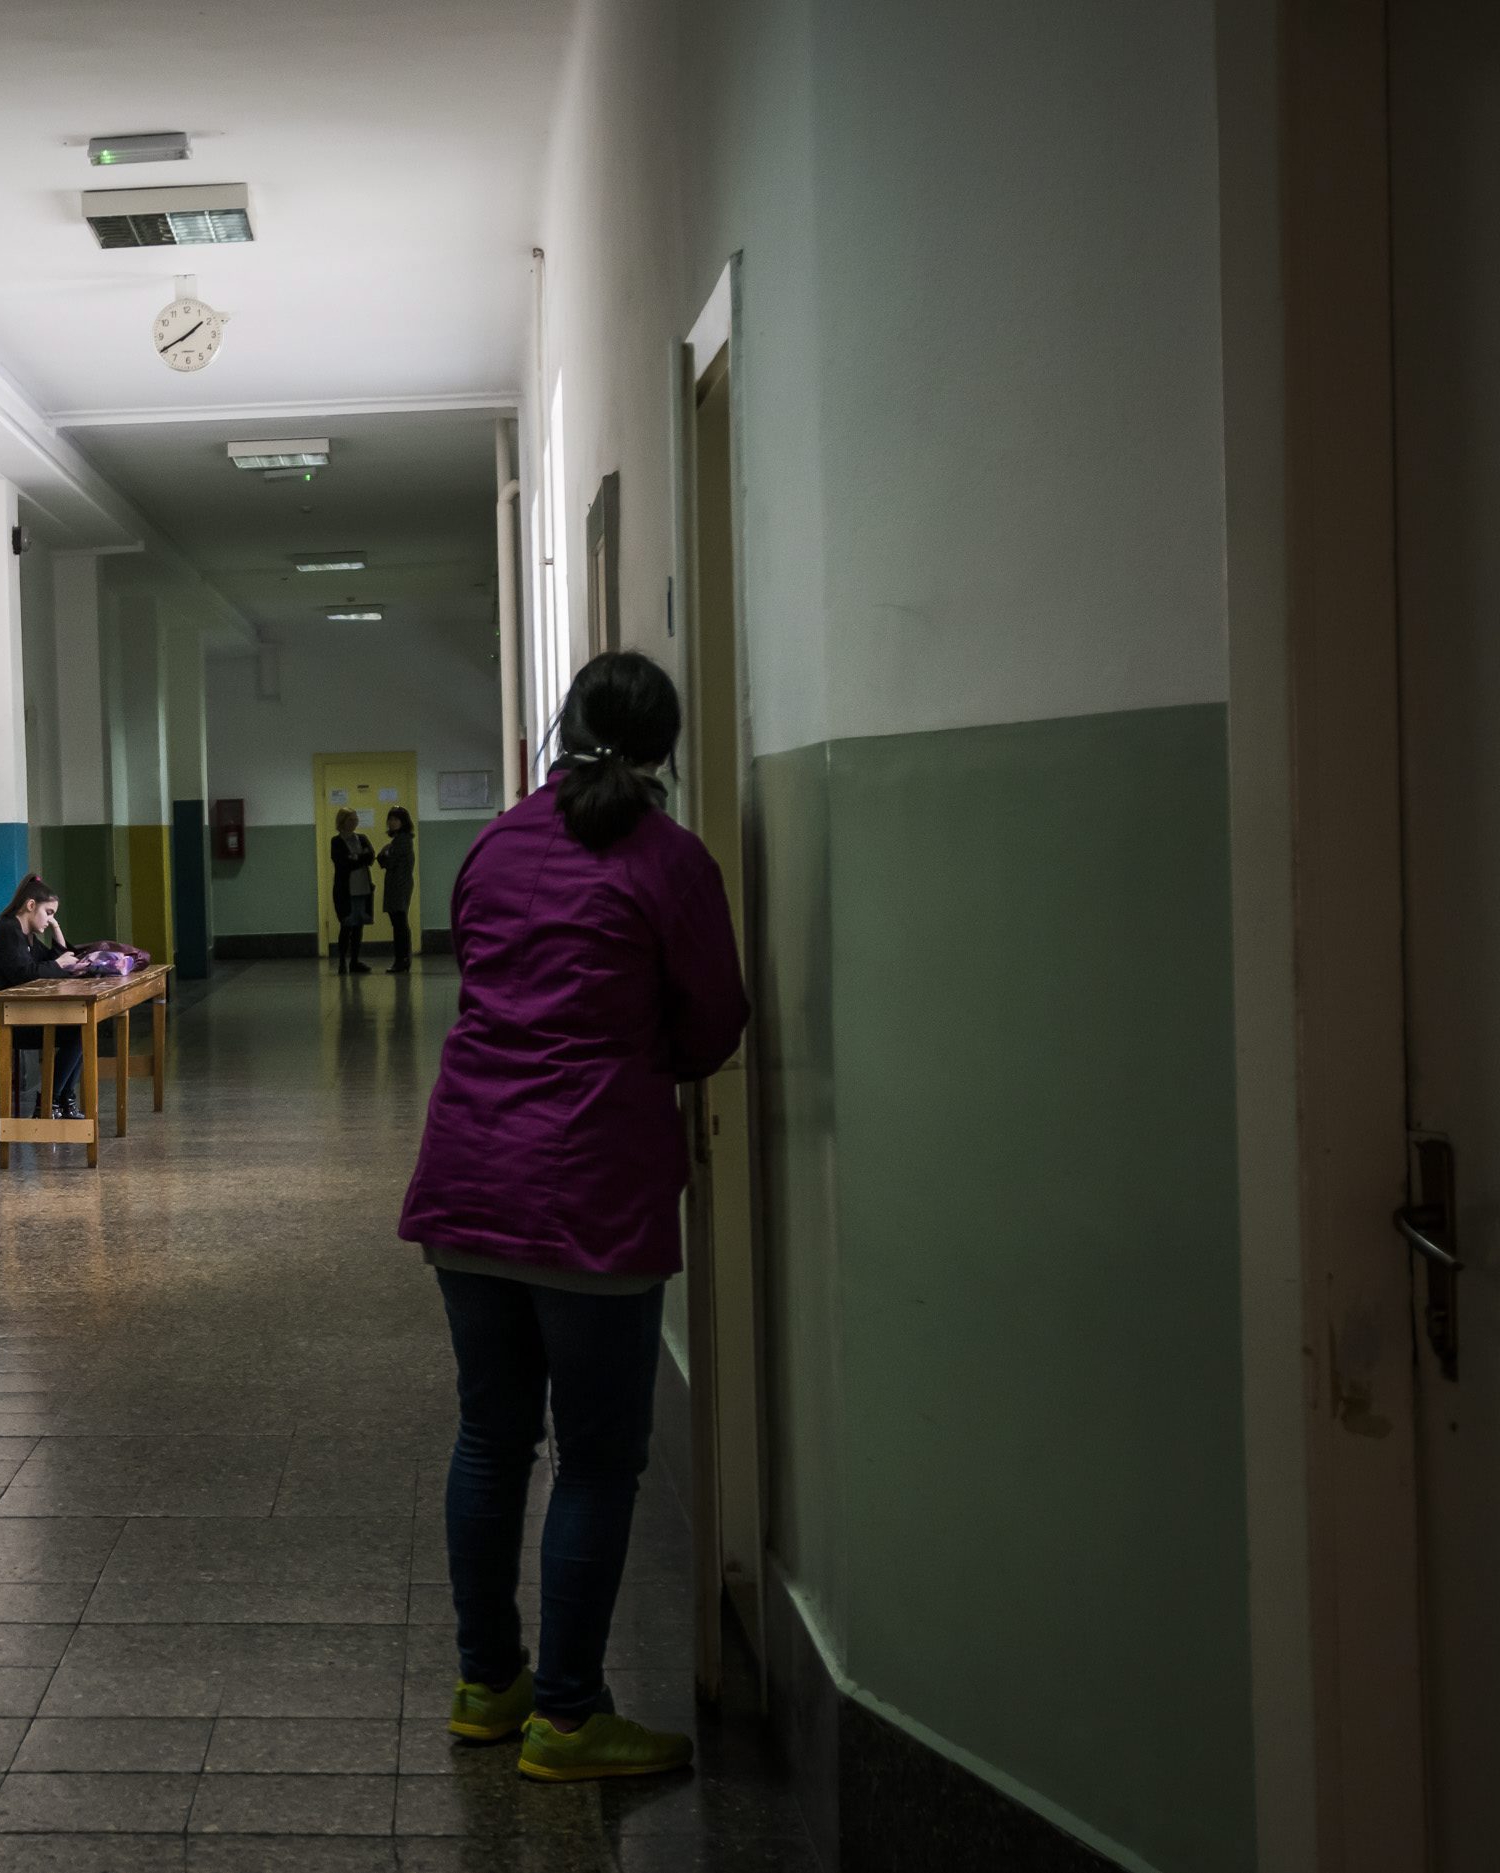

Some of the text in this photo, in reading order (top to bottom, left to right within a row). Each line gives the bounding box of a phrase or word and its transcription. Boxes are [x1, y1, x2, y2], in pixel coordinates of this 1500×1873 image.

[171, 310, 177, 318] 11
[183, 306, 191, 314] 12
[162, 319, 169, 327] 10
[206, 317, 212, 325] 2
[211, 330, 217, 338] 3
[172, 353, 177, 361] 7
[186, 356, 191, 364] 6
[198, 352, 204, 360] 5
